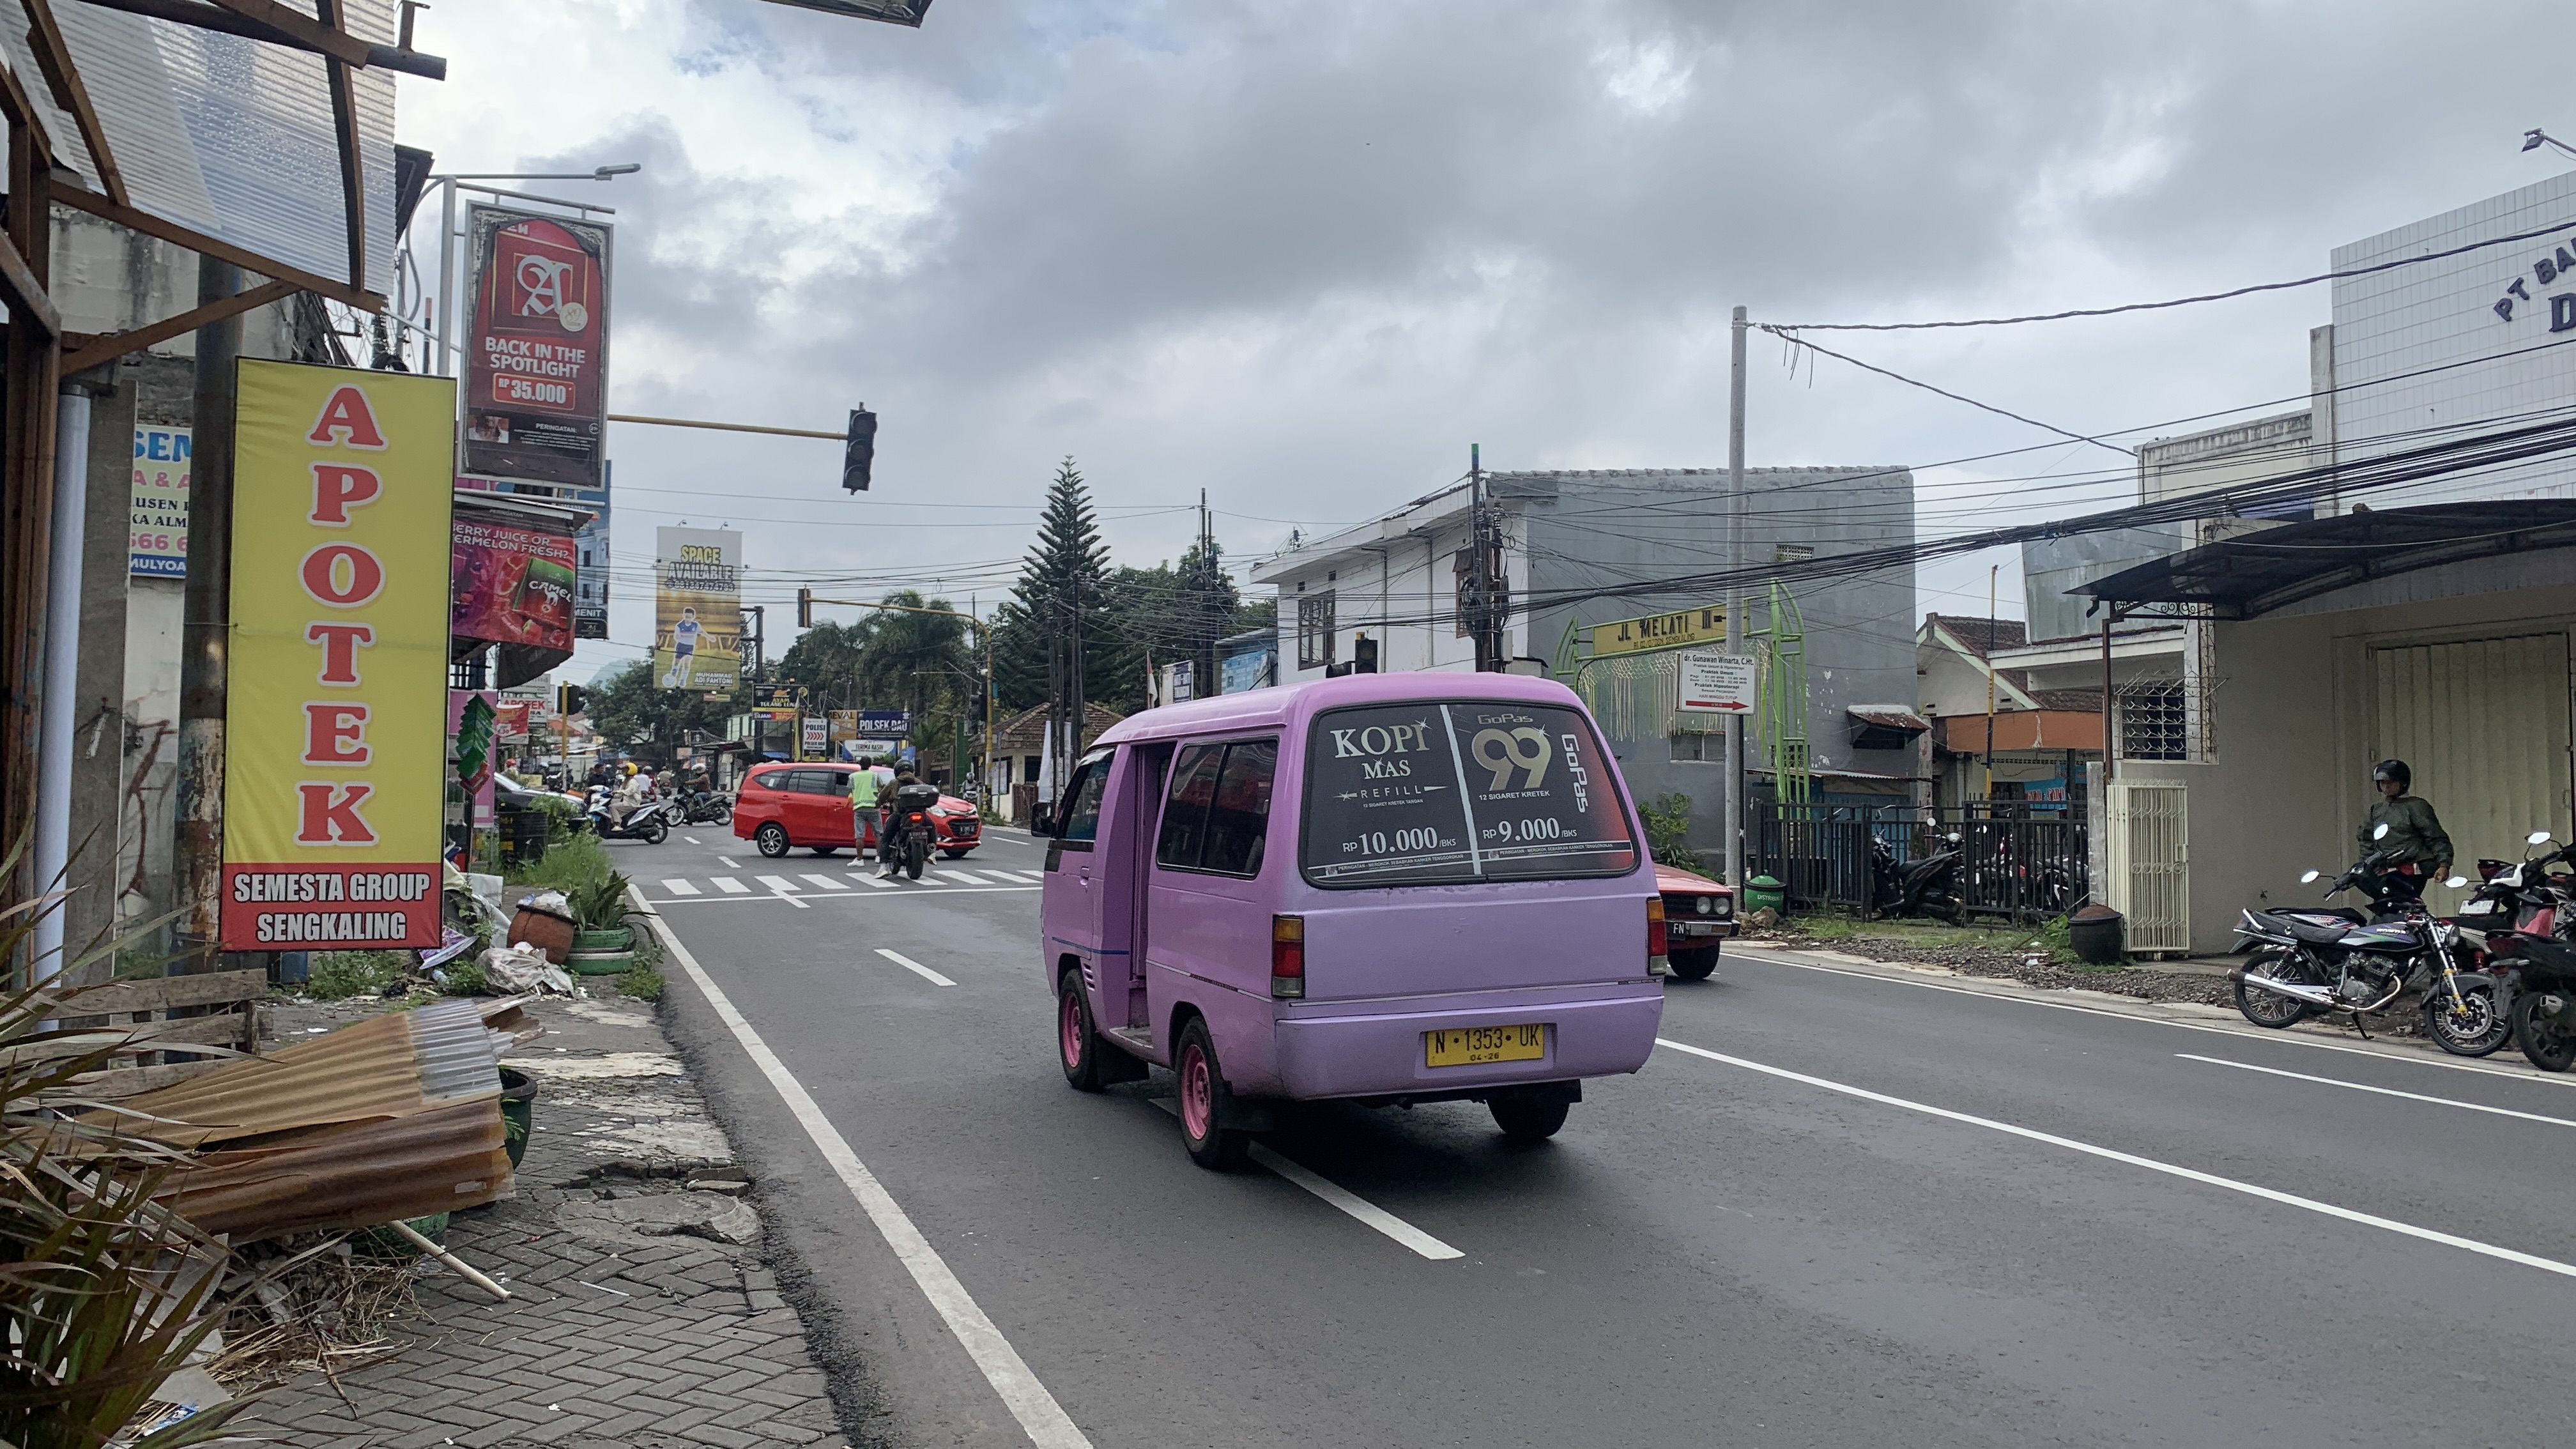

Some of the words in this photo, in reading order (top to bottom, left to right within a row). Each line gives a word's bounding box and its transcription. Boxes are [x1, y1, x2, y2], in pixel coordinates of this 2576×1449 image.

[2493, 277, 2529, 322] PT
[486, 337, 531, 356] BACK
[535, 344, 551, 358] IN
[555, 346, 586, 364] THE
[490, 354, 580, 378] SPOTLIGHT
[155, 471, 169, 487] &
[133, 497, 178, 510] USEN
[493, 530, 528, 543] JUICE
[532, 537, 549, 547] OR
[521, 544, 569, 559] FRESH?
[681, 545, 721, 565] SPACE
[668, 562, 733, 581] AVAILABLE
[529, 581, 571, 602] CAMEL
[293, 383, 388, 847] APOTEK
[1639, 614, 1689, 638] MELATI
[1692, 655, 1717, 663] Gunawan
[859, 719, 889, 732] POLSEK
[1477, 713, 1533, 724] GoPas
[1330, 723, 1430, 759] KOPI
[1361, 759, 1411, 779] MAS
[1471, 726, 1552, 792] 99
[1561, 734, 1589, 813] GoPas
[1360, 785, 1422, 799] REFILL
[1489, 792, 1521, 800] SIGARET
[1521, 790, 1551, 798] KRETEK
[1342, 841, 1358, 852] RP
[1359, 827, 1438, 855] 10.000
[1439, 838, 1457, 847] /BKS
[1482, 829, 1497, 839] RP
[1498, 817, 1560, 843] 9.000
[1561, 829, 1577, 838] /BKS
[234, 873, 346, 902] SEMESTA
[349, 873, 430, 901] GROUP
[257, 912, 407, 942] SENGKALING
[1435, 1031, 1445, 1054] N
[1464, 1027, 1503, 1052] 1353
[1519, 1023, 1540, 1046] UK
